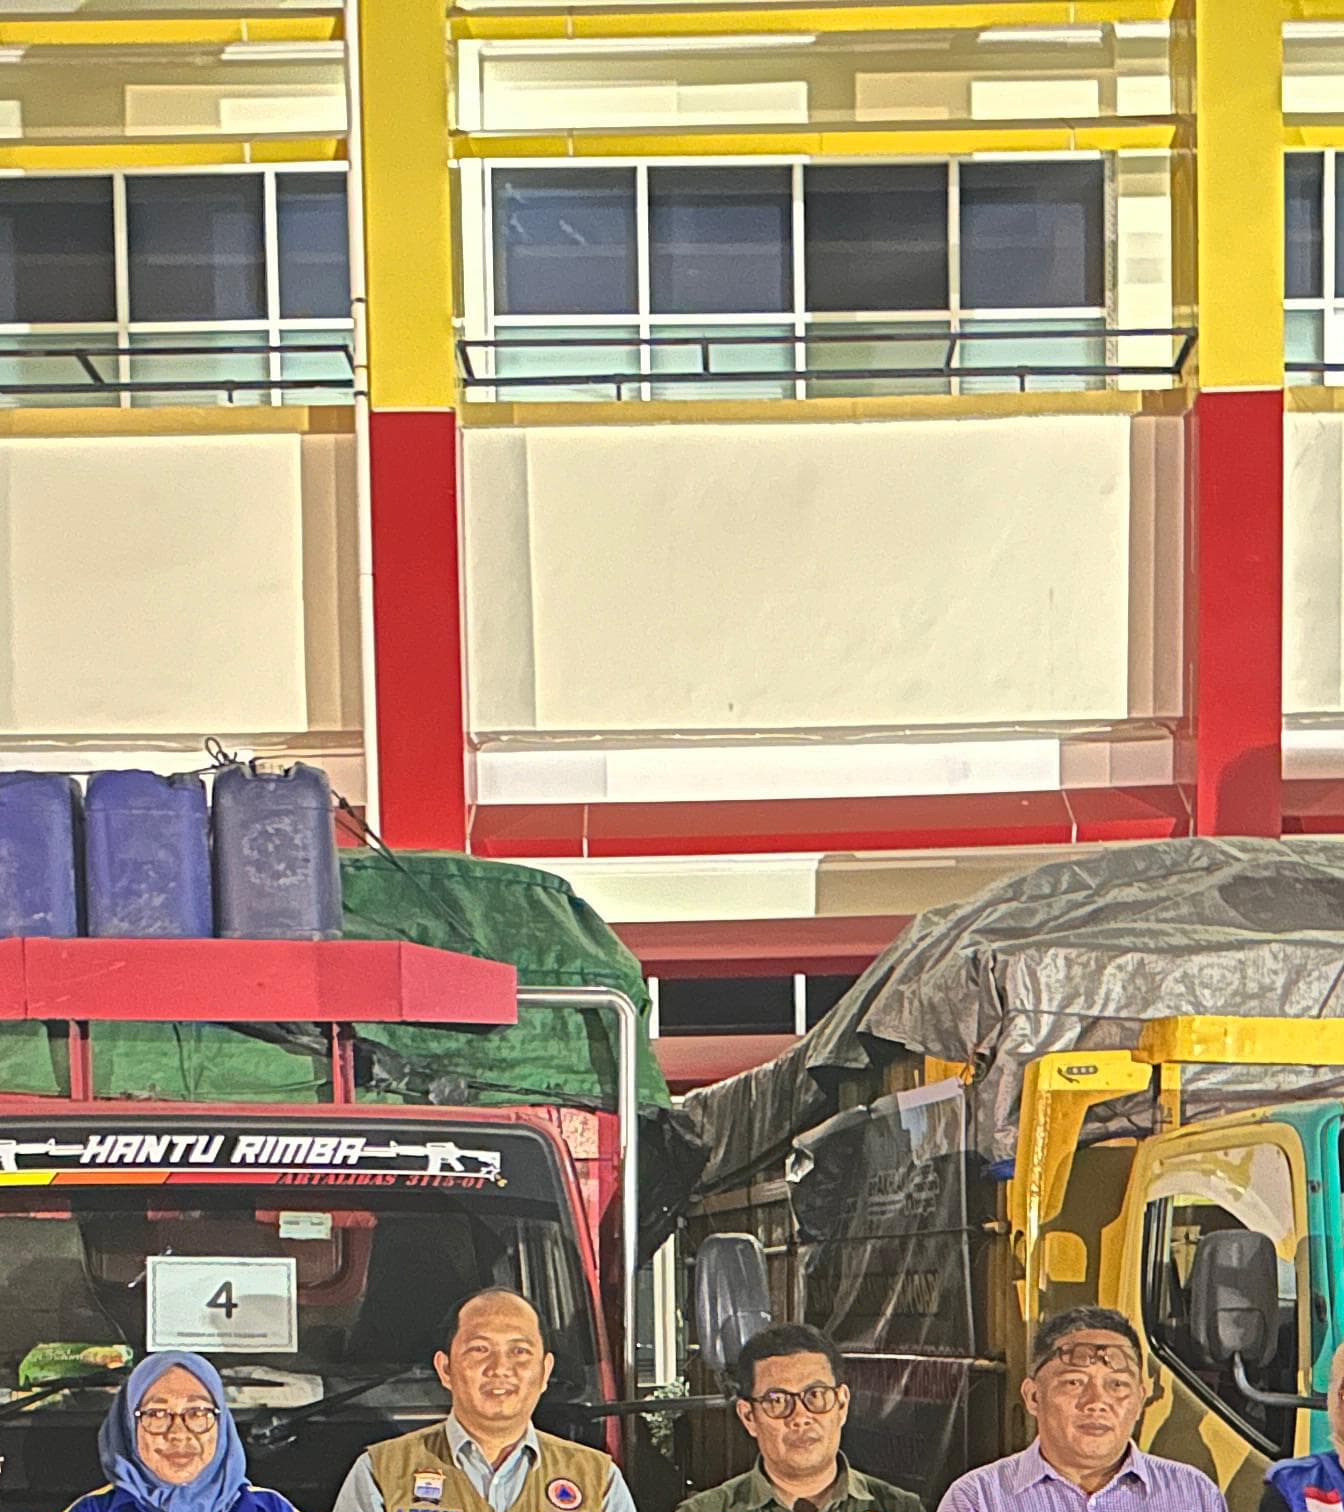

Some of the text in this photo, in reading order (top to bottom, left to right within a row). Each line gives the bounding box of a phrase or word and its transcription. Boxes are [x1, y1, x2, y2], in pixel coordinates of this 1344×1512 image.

[81, 1135, 367, 1166] HANTU RIMBA
[206, 1280, 238, 1319] 4
